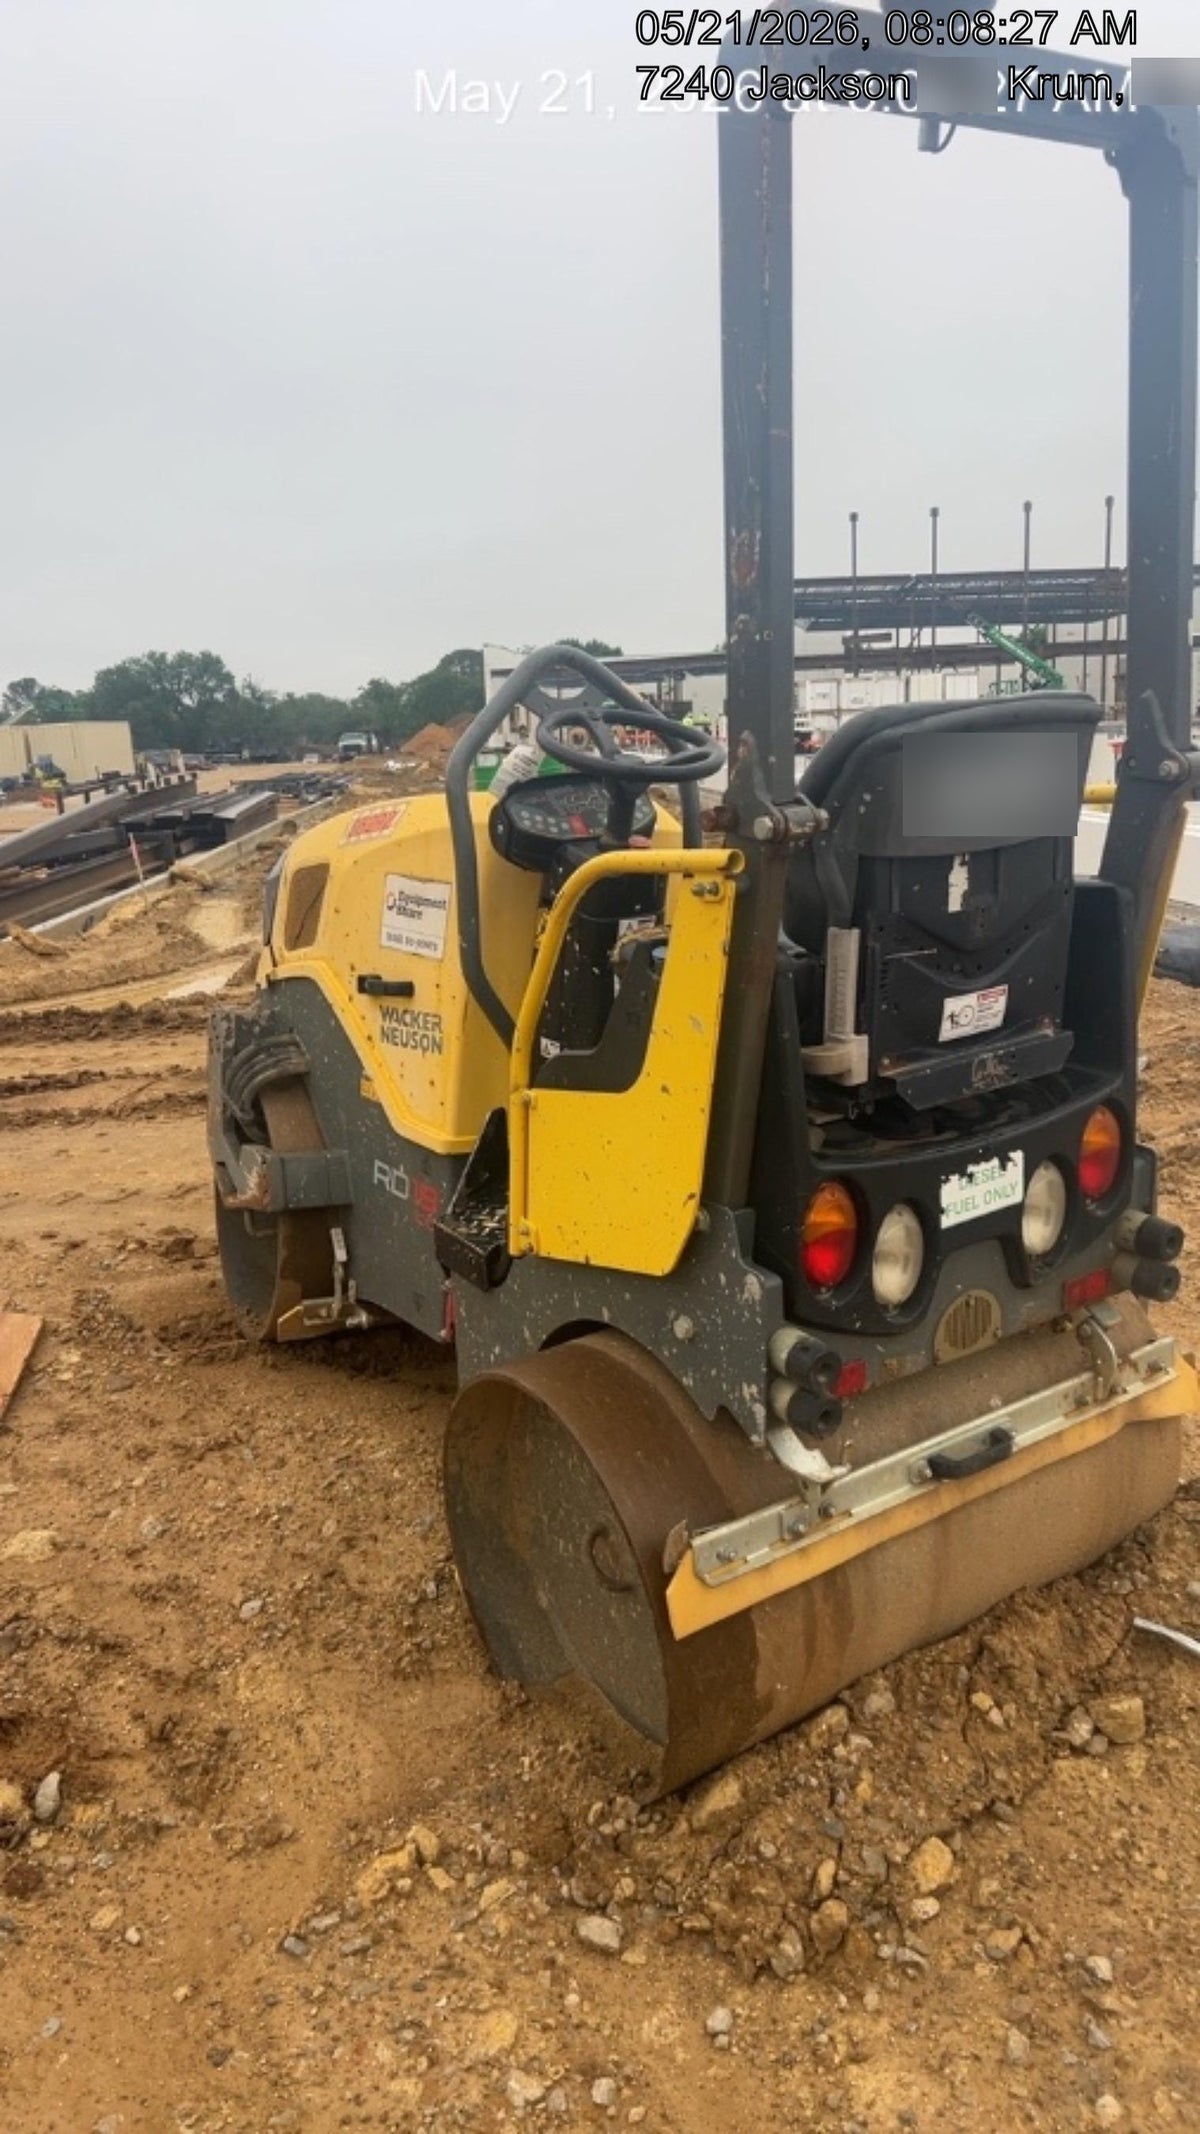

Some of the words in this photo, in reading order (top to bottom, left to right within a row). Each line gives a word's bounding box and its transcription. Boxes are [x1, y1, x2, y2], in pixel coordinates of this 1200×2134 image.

[398, 890, 447, 911] Equipment
[379, 1005, 443, 1034] WACKER
[381, 1023, 443, 1055] NEUSON
[943, 1196, 981, 1219] FUEL
[983, 1181, 1019, 1206] ONLY
